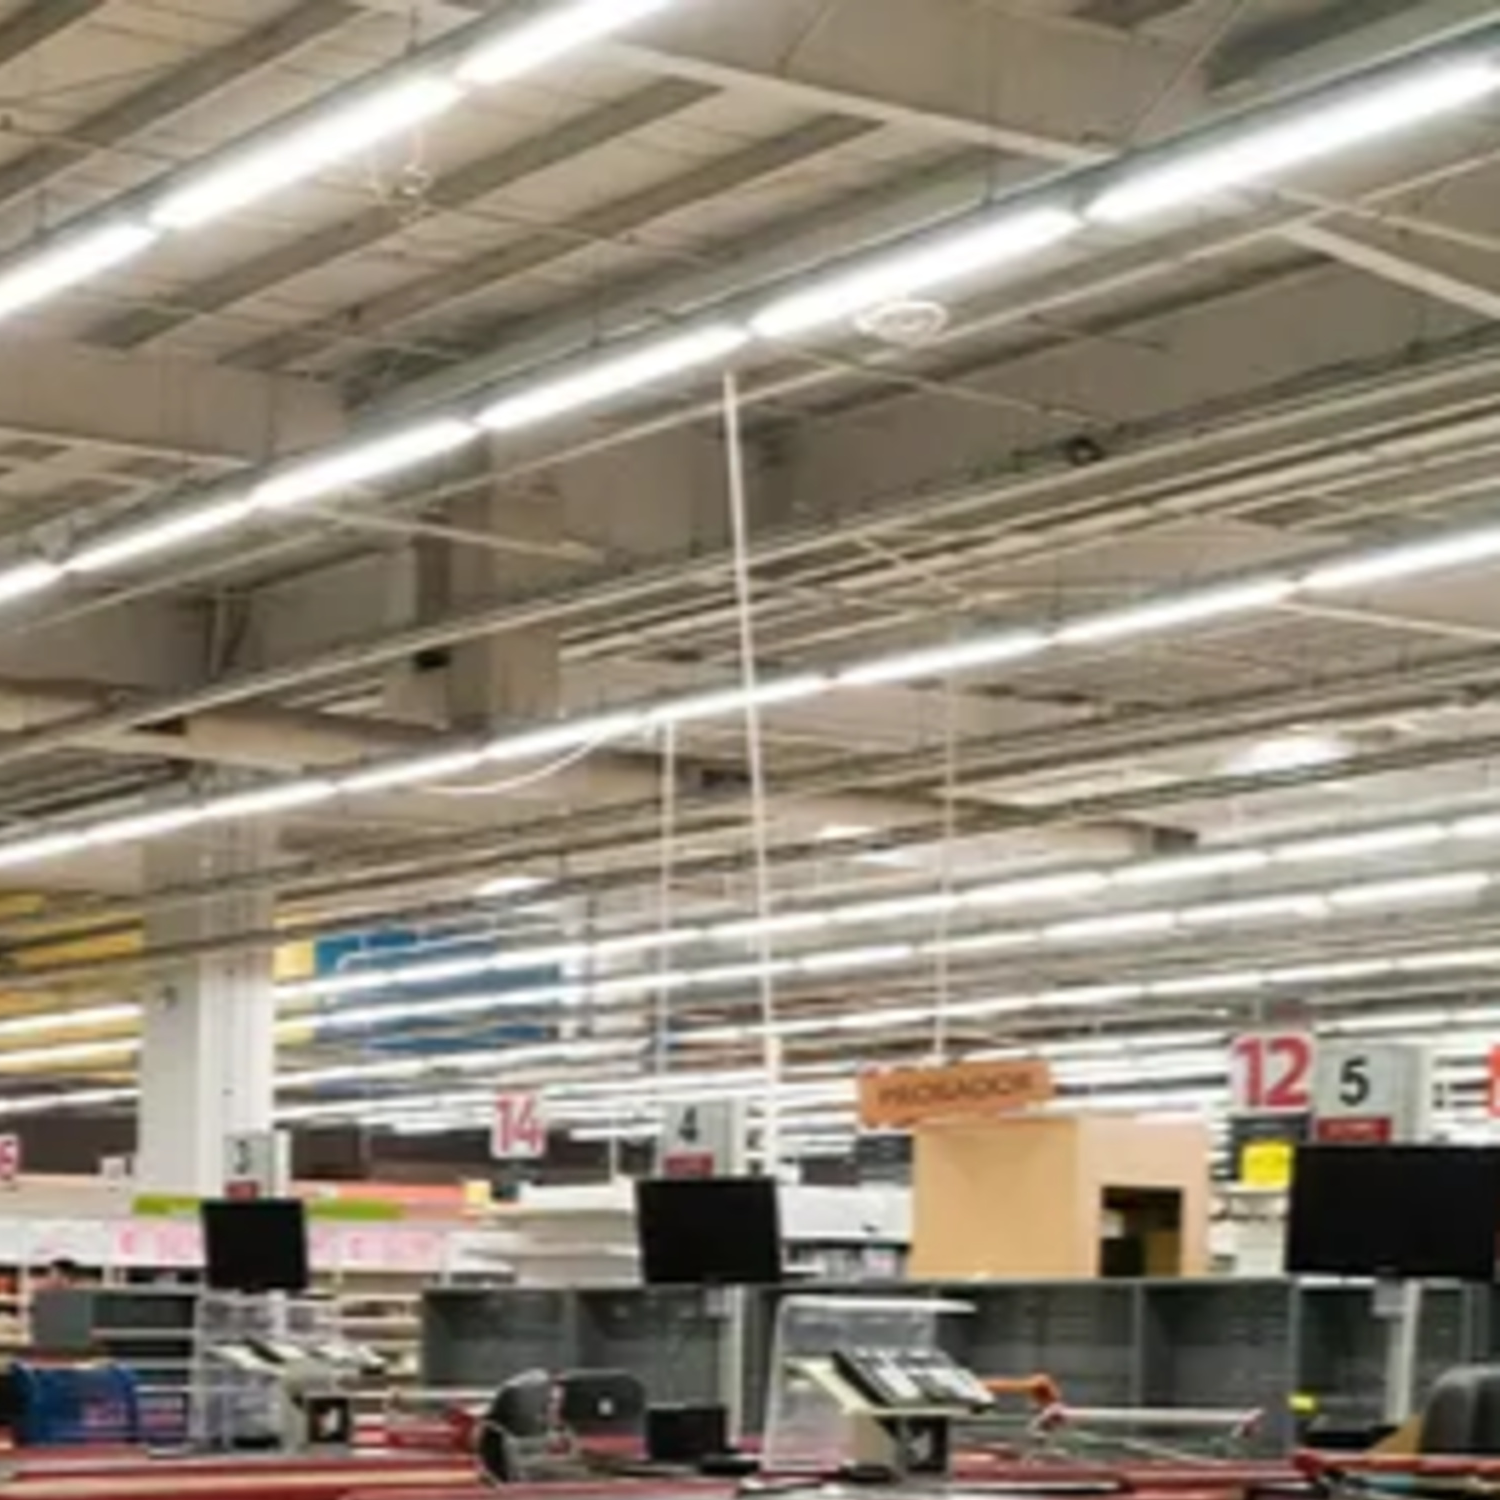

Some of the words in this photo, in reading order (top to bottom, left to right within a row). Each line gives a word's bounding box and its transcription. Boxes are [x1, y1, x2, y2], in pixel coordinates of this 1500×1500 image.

[1235, 1037, 1309, 1106] 12
[1340, 1056, 1370, 1106] 5
[494, 1095, 543, 1151] 14
[678, 1105, 698, 1142] 4
